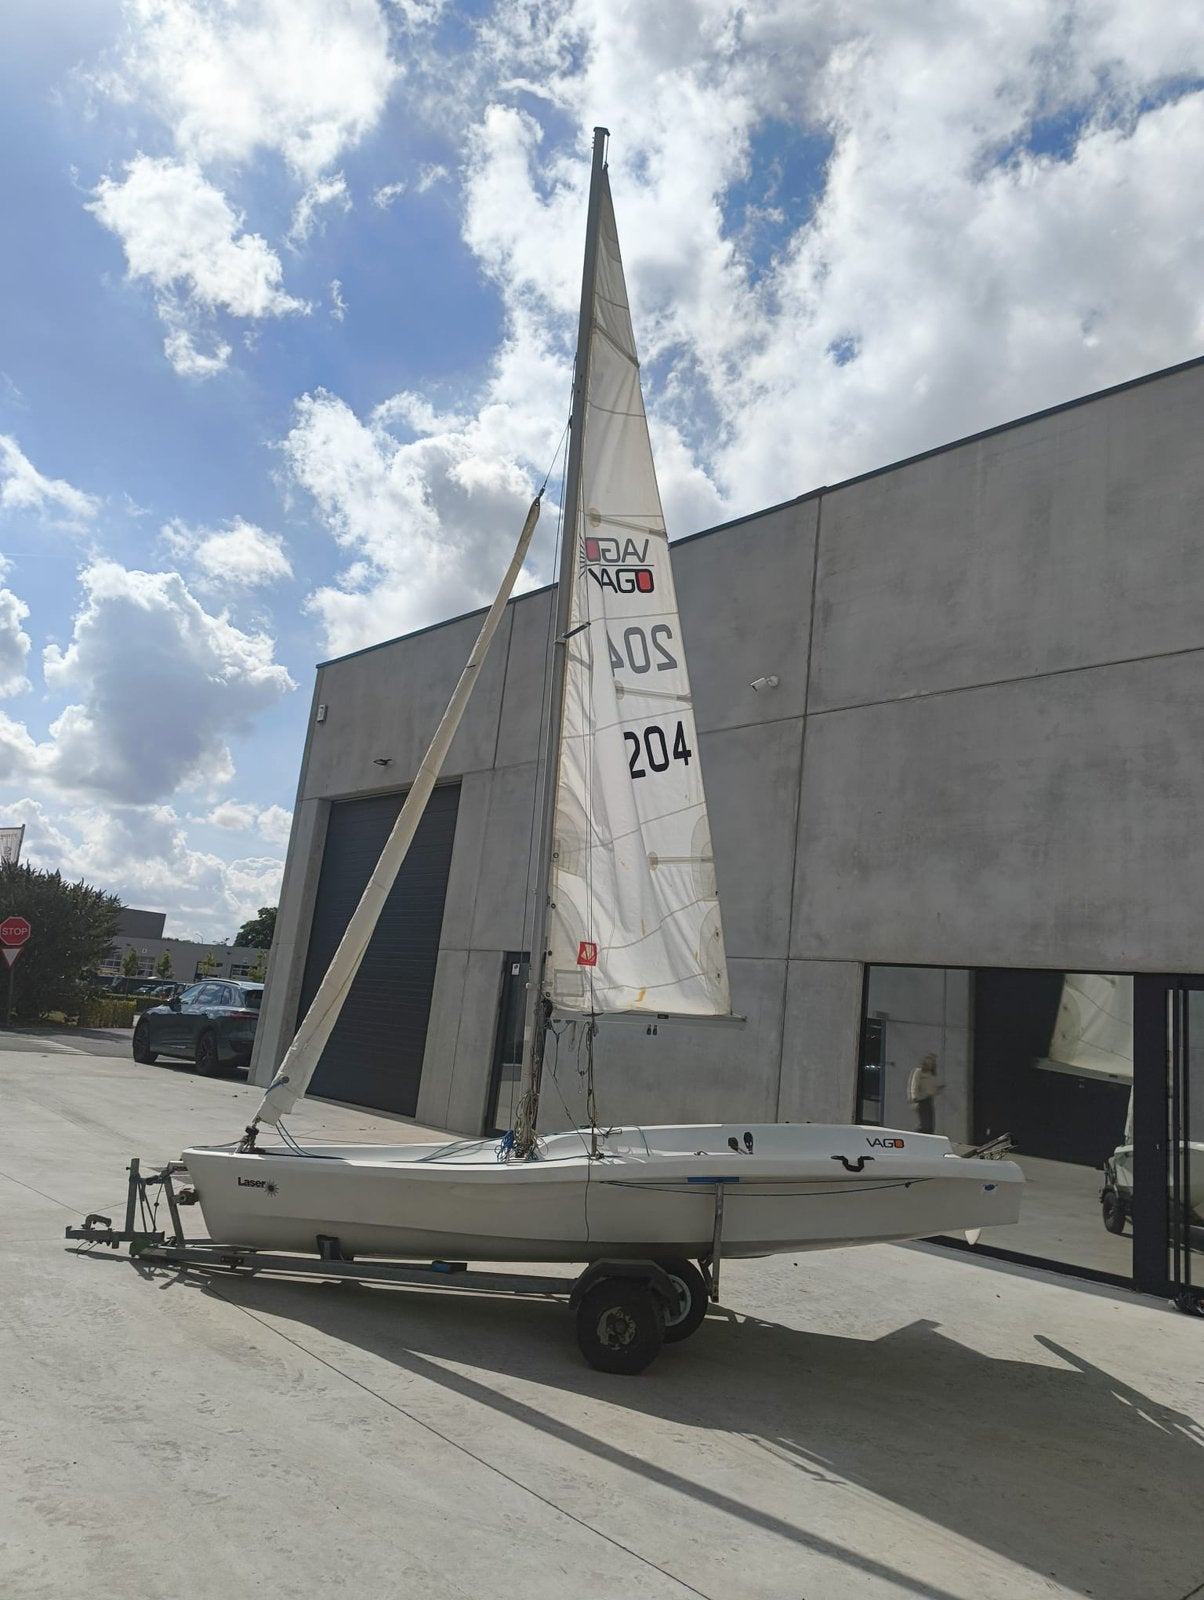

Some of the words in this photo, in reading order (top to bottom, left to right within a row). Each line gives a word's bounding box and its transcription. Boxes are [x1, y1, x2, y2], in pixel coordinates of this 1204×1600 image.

[588, 568, 654, 593] VAGO
[624, 721, 692, 779] 204
[2, 927, 28, 936] STOP
[866, 1137, 905, 1149] VAGO
[238, 1177, 266, 1188] Laser
